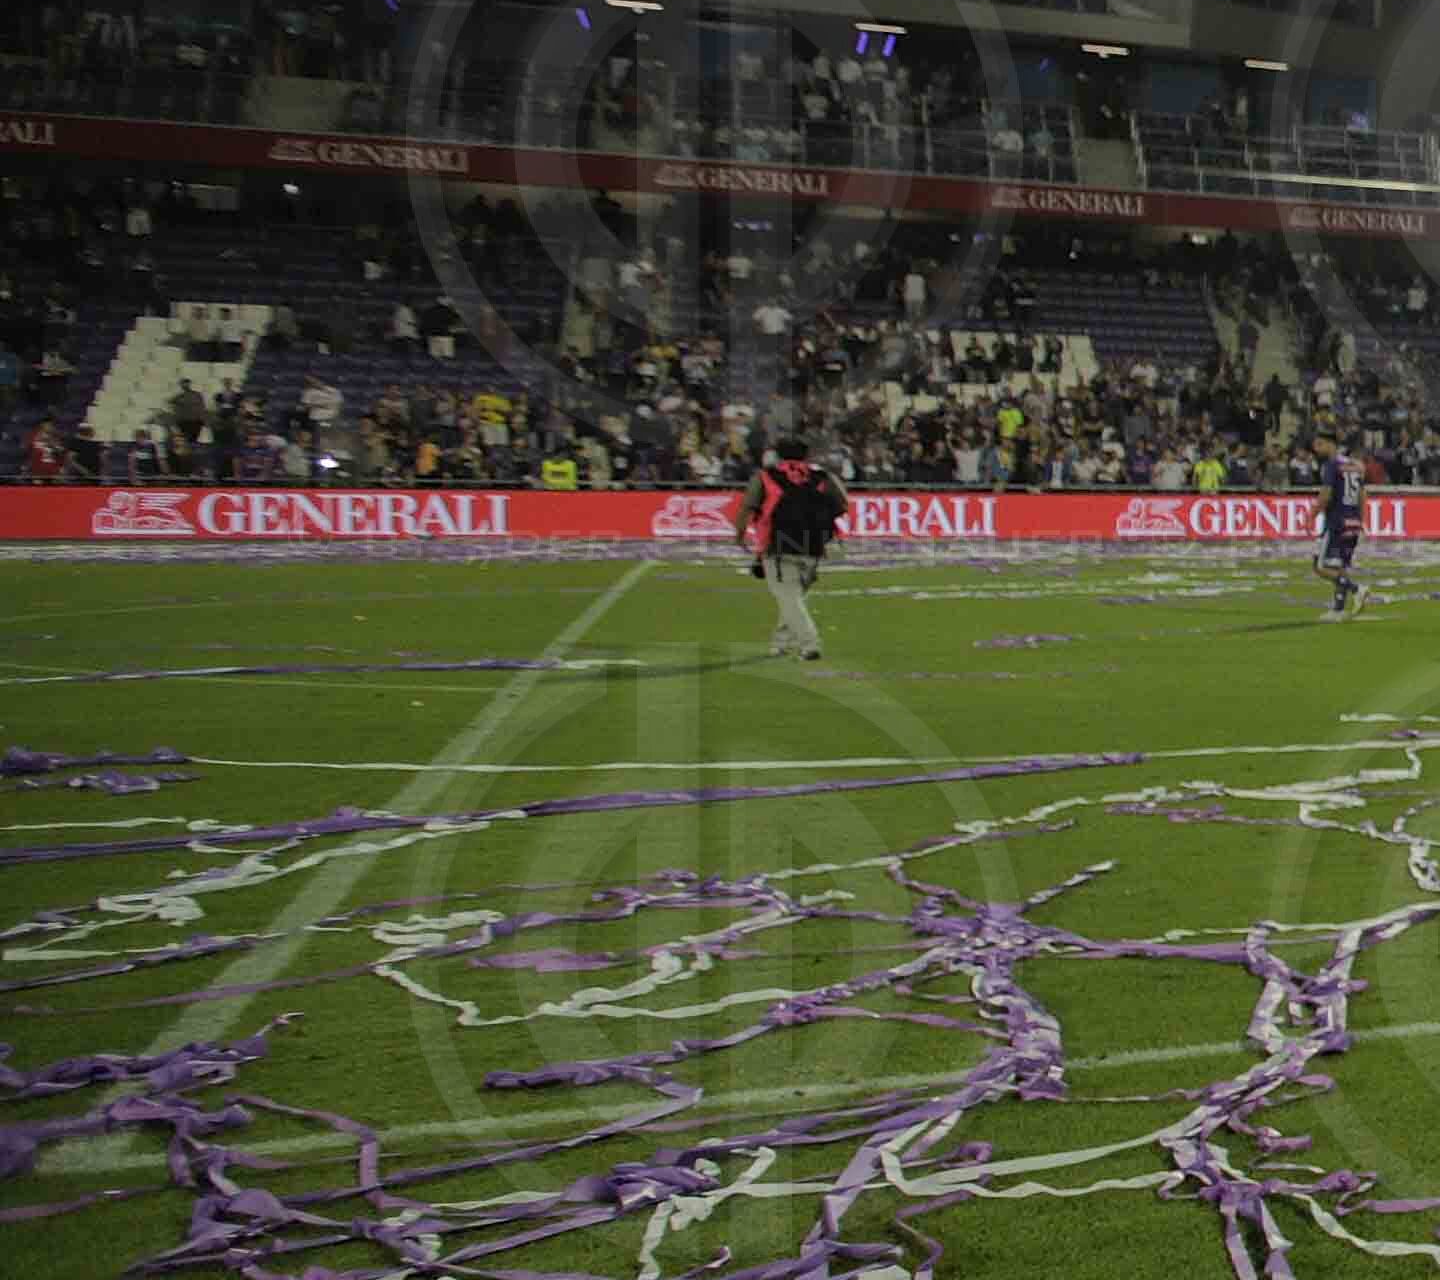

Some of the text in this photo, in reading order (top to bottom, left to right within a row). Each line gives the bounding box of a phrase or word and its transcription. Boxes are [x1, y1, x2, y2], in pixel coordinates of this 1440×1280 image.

[317, 143, 470, 173] GENERALI
[699, 167, 829, 196] GENERALI
[1029, 190, 1145, 216] GENERALI
[198, 490, 511, 538] GENERALI
